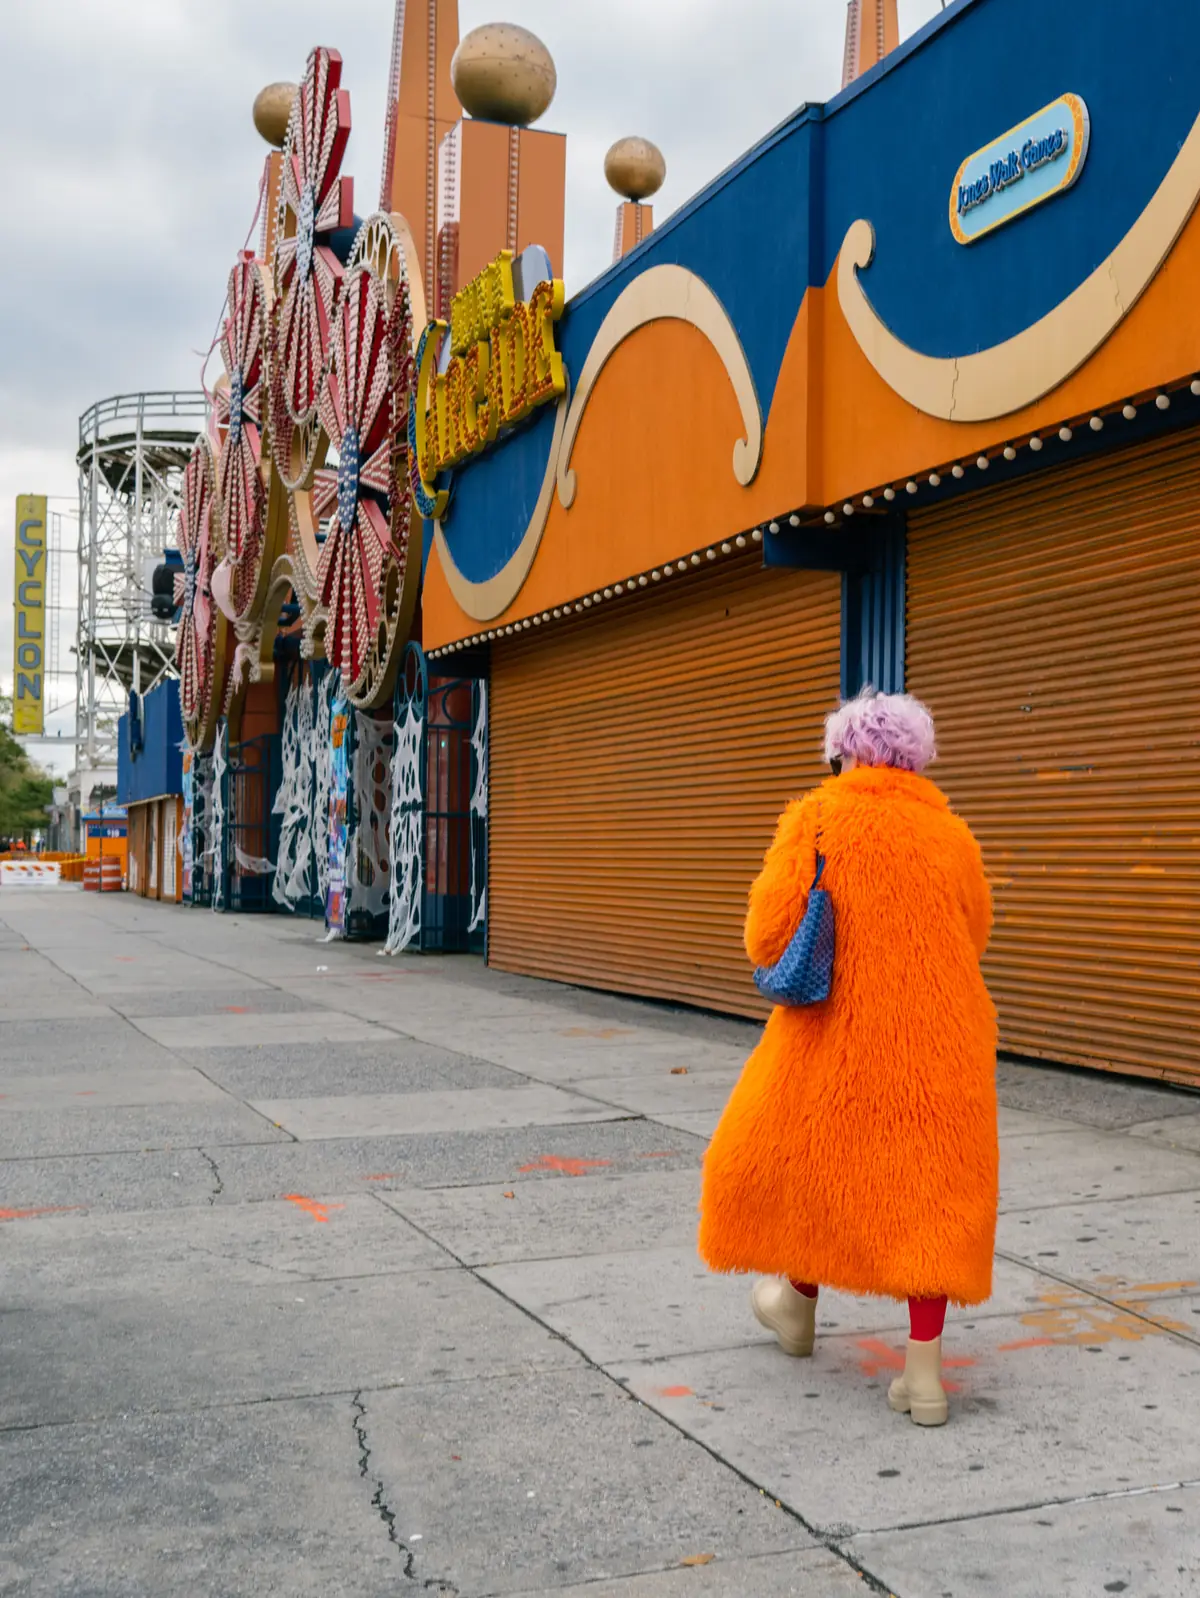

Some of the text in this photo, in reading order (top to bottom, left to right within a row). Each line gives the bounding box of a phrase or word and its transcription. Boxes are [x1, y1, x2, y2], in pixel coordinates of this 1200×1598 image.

[958, 129, 1066, 213] Jones Walk Games
